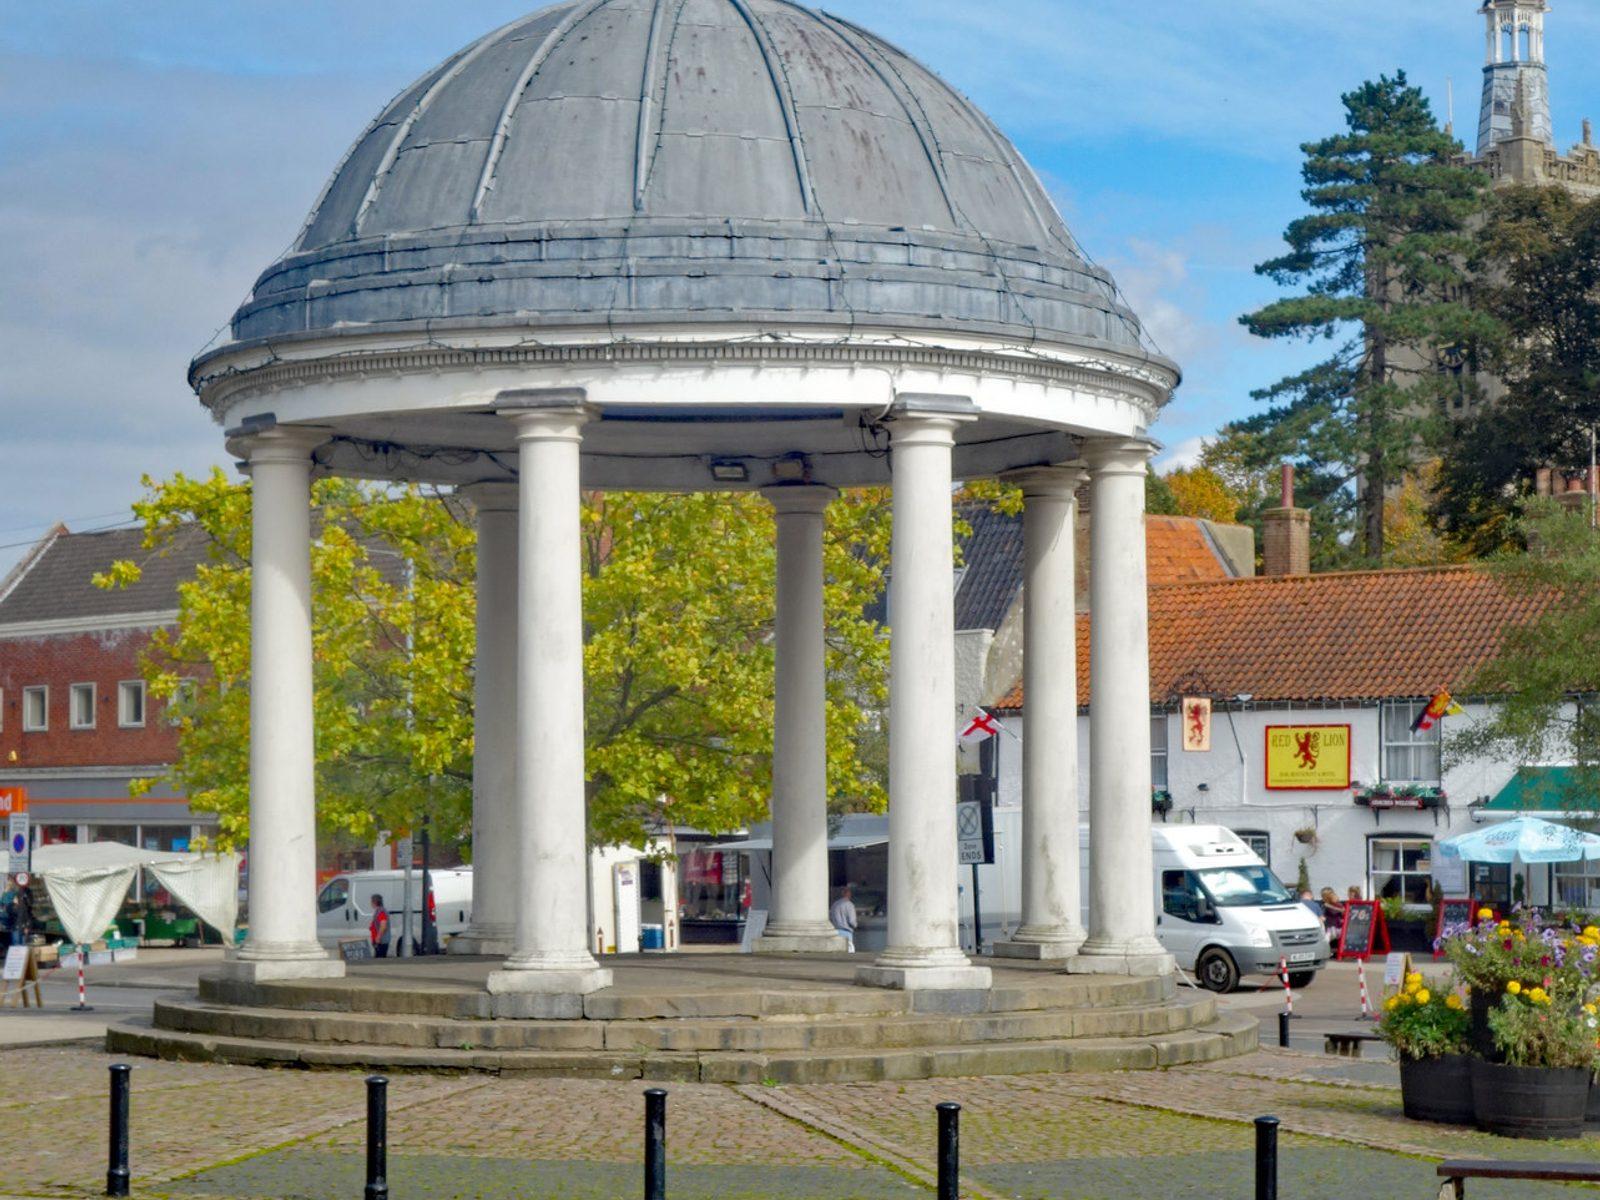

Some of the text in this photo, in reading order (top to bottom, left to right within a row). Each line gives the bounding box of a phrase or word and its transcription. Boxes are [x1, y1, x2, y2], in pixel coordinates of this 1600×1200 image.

[1272, 734, 1345, 747] RED LION
[961, 850, 982, 861] ENDS
